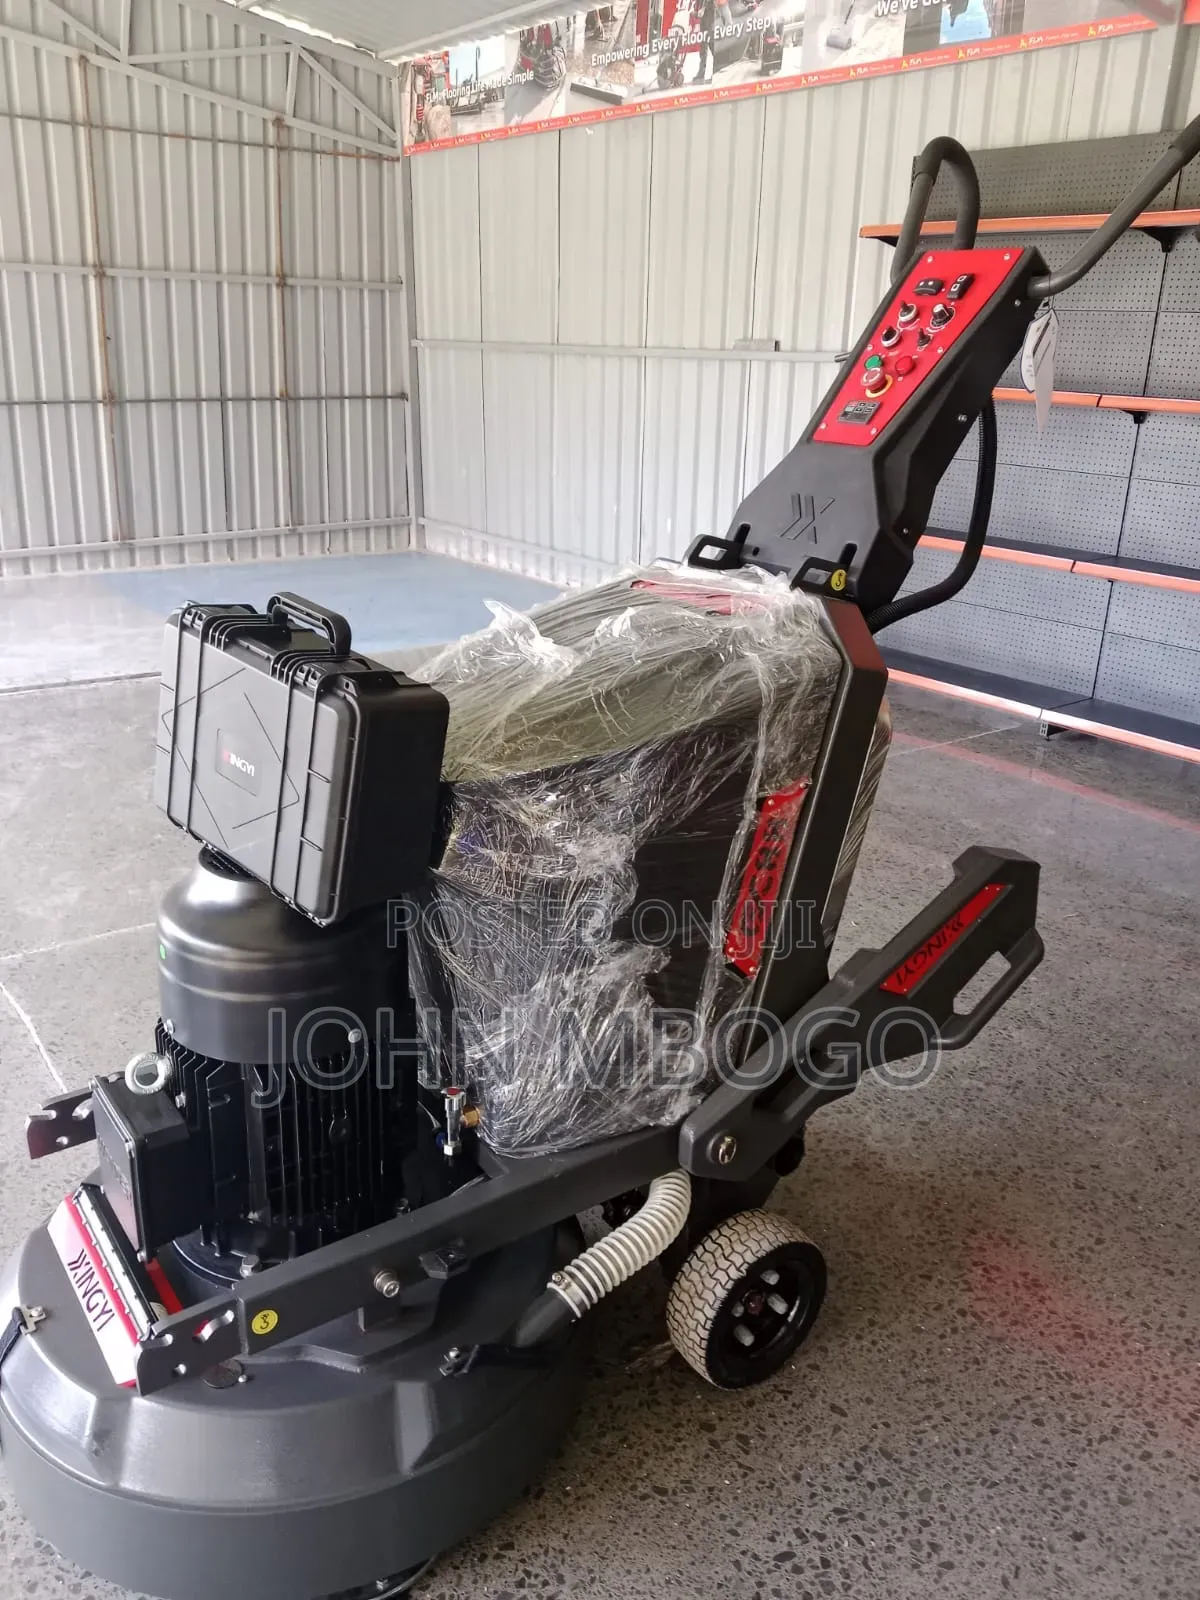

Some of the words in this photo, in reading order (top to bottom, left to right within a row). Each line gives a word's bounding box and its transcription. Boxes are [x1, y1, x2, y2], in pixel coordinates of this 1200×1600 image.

[591, 42, 649, 67] Empowering
[652, 37, 678, 54] Every
[681, 28, 710, 48] Floor,
[713, 21, 744, 40] Every
[507, 68, 534, 86] Simple
